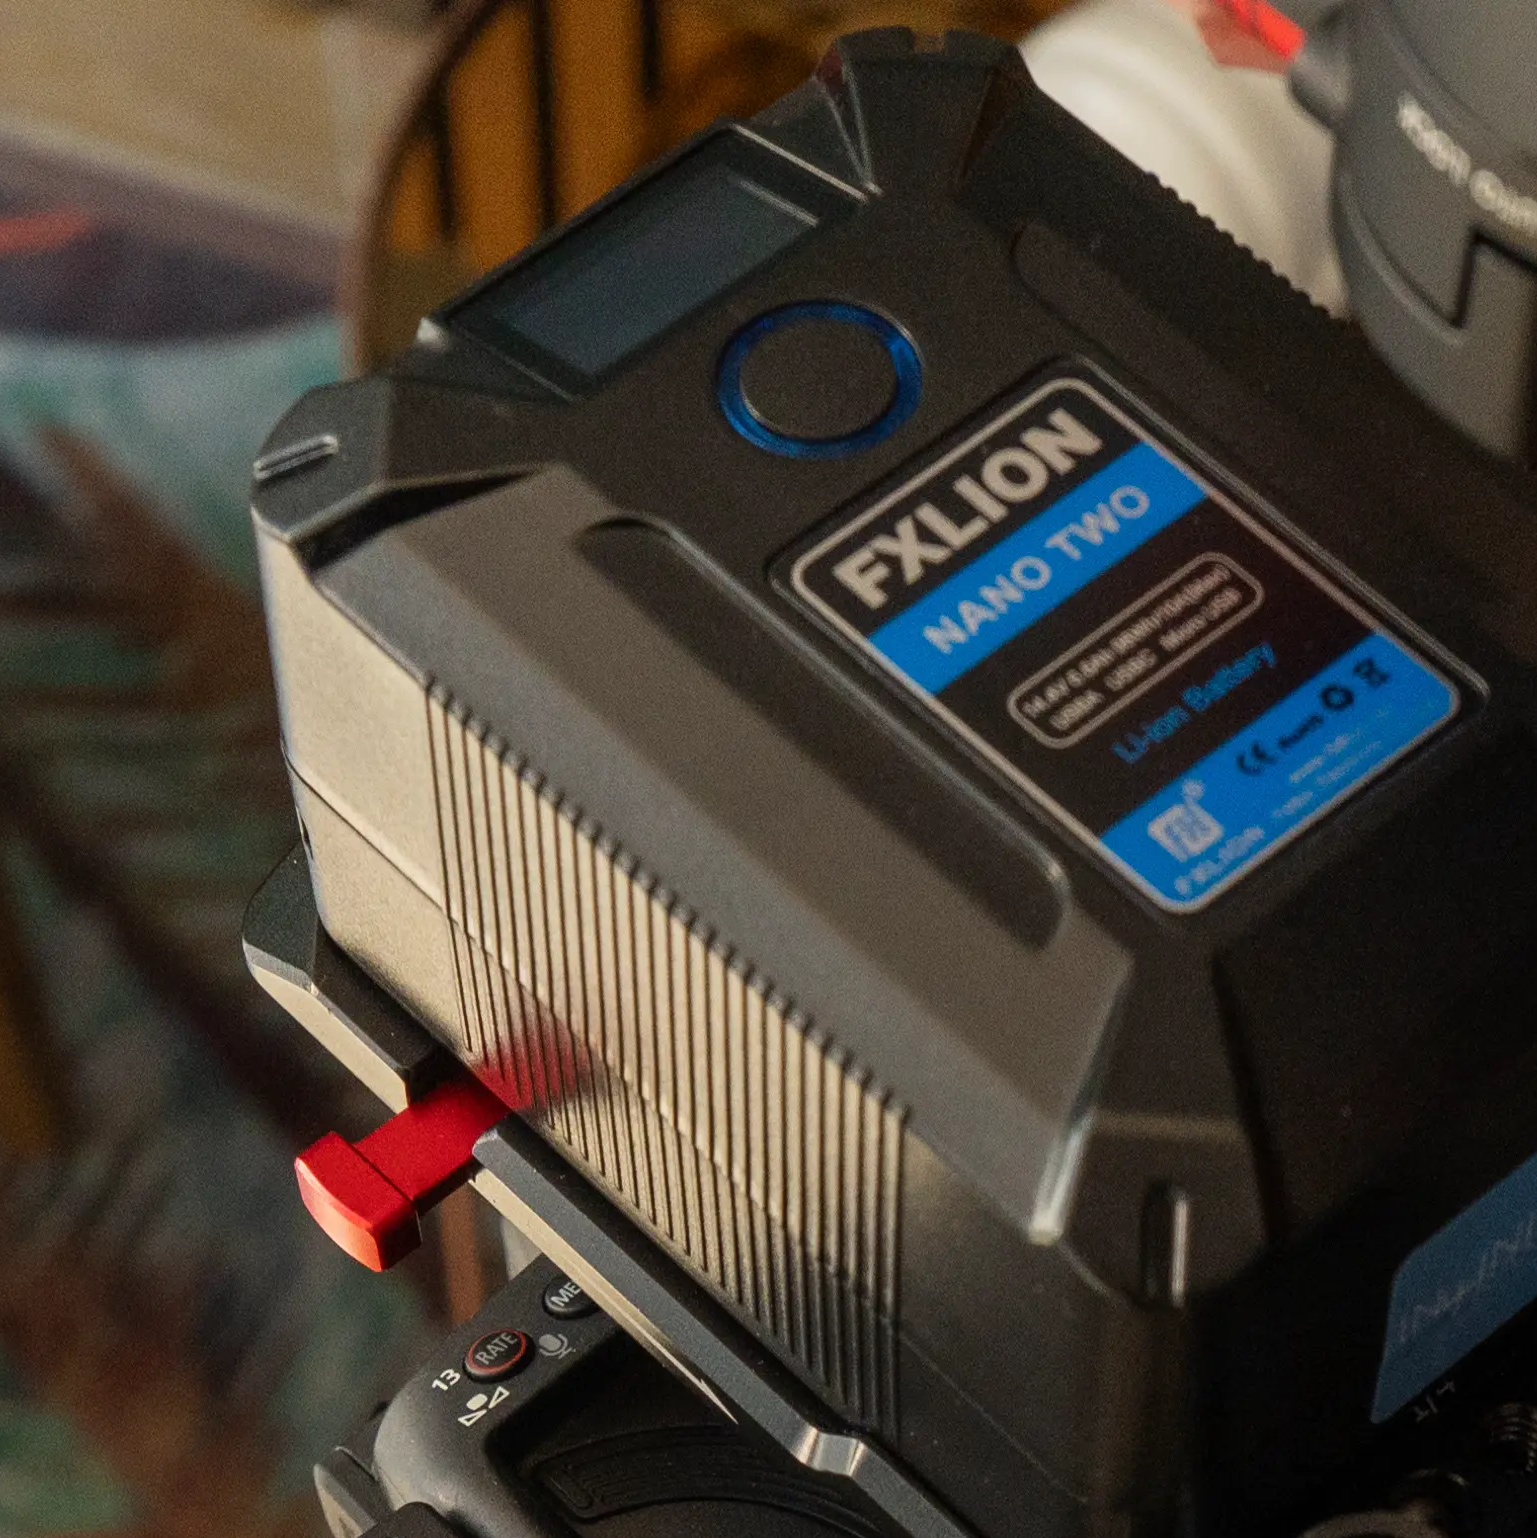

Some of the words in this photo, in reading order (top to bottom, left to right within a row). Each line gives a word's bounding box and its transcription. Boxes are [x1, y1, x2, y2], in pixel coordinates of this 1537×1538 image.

[831, 407, 1104, 610] FXLION
[922, 555, 1053, 655] NANO
[1044, 484, 1151, 561] TWO
[1181, 641, 1276, 713] Battery
[550, 1281, 582, 1308] ME
[475, 1332, 519, 1365] RATE
[431, 1368, 461, 1391] 13
